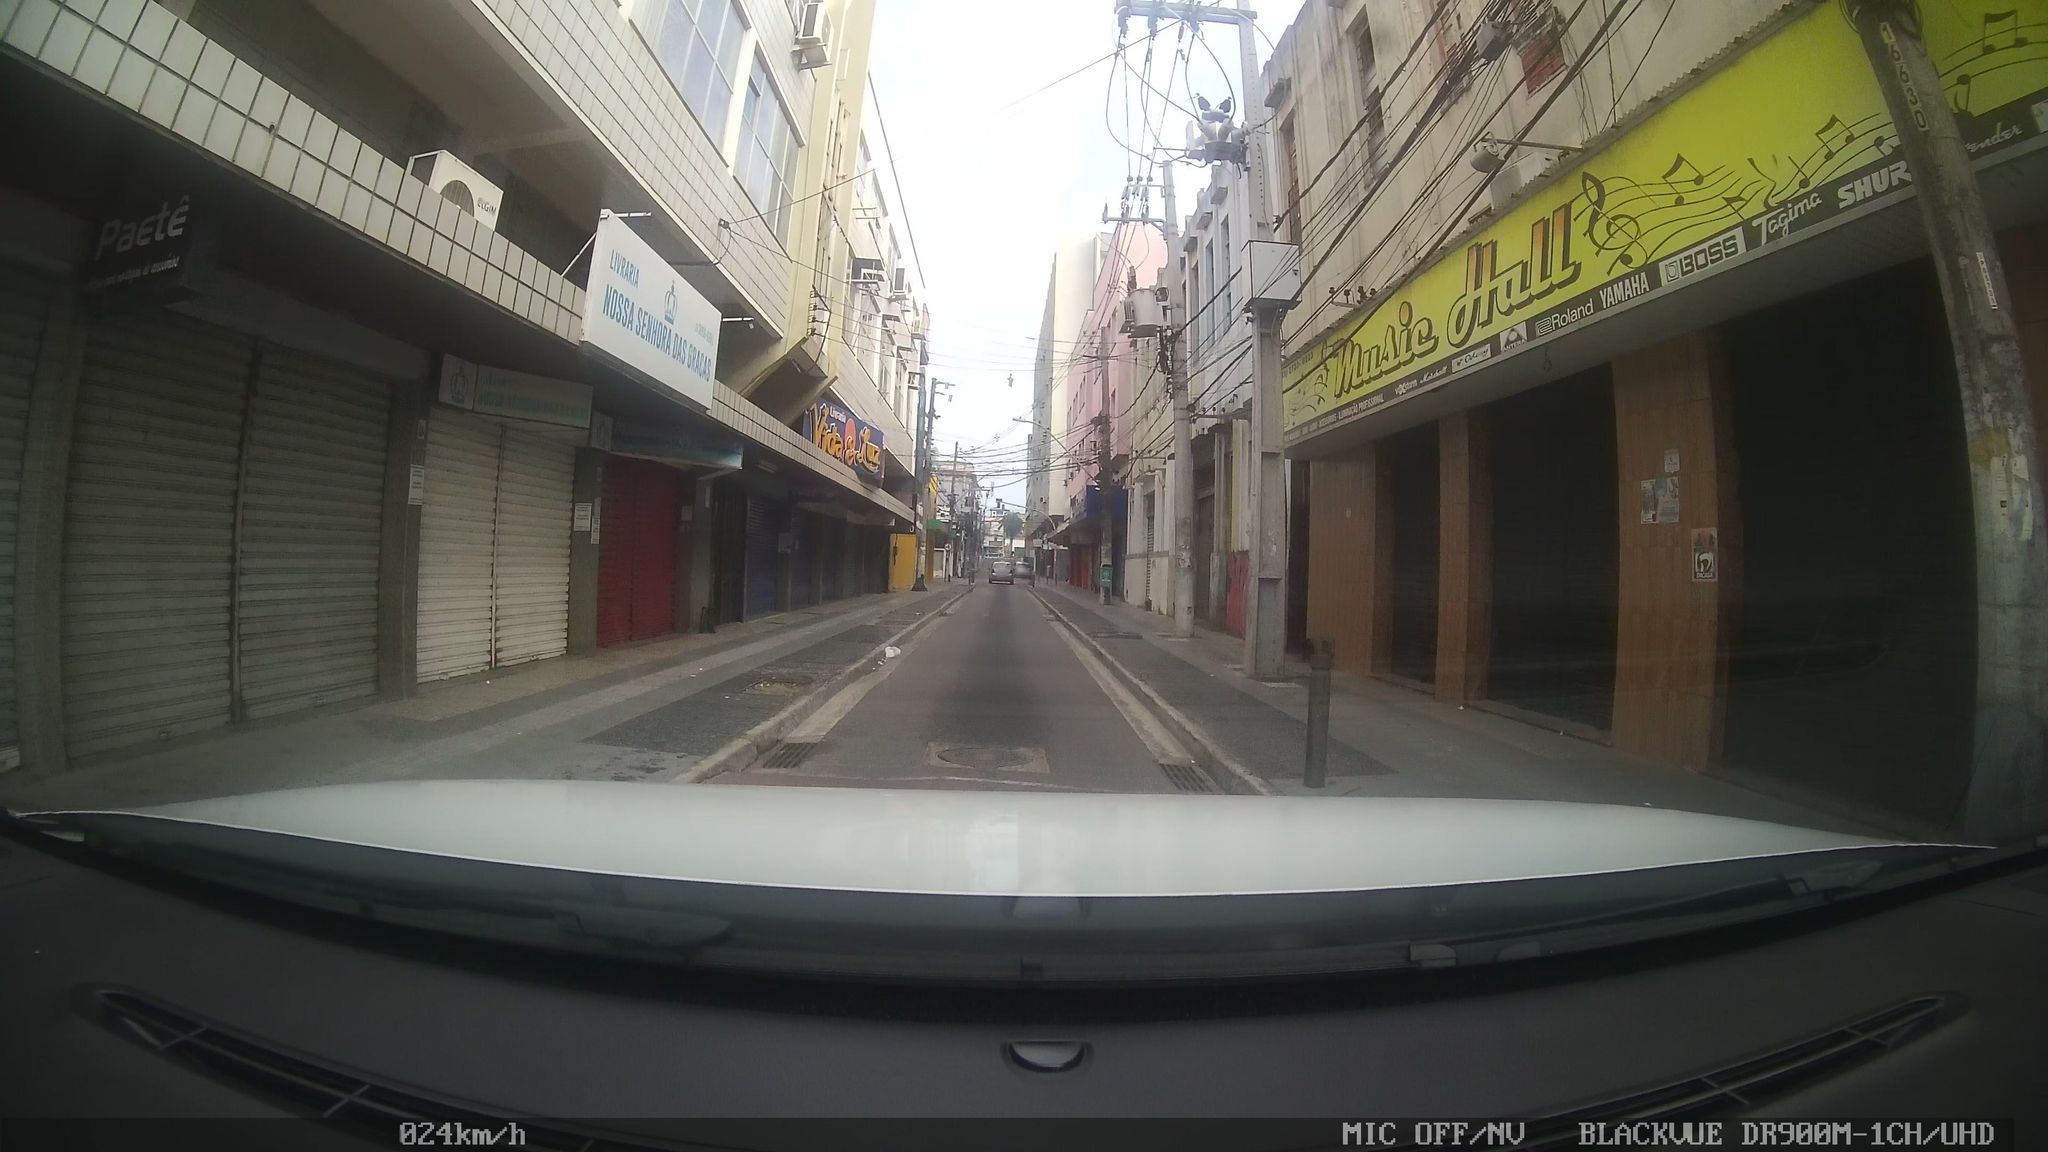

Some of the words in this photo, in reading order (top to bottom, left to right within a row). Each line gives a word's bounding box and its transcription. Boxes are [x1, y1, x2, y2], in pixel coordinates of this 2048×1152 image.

[1838, 160, 1912, 209] SHUR
[1752, 192, 1822, 246] Tagima
[610, 249, 640, 287] LIVRARIA
[1680, 234, 1739, 277] BOSS
[1334, 301, 1439, 398] Music
[1447, 203, 1582, 349] Hall
[1551, 298, 1594, 331] Roland
[1599, 272, 1650, 309] YAMAHA
[602, 284, 635, 330] NOSSA
[635, 308, 672, 355] SENHORA
[672, 332, 687, 365] DAS
[810, 402, 844, 462] Vida
[855, 426, 881, 473] Luz
